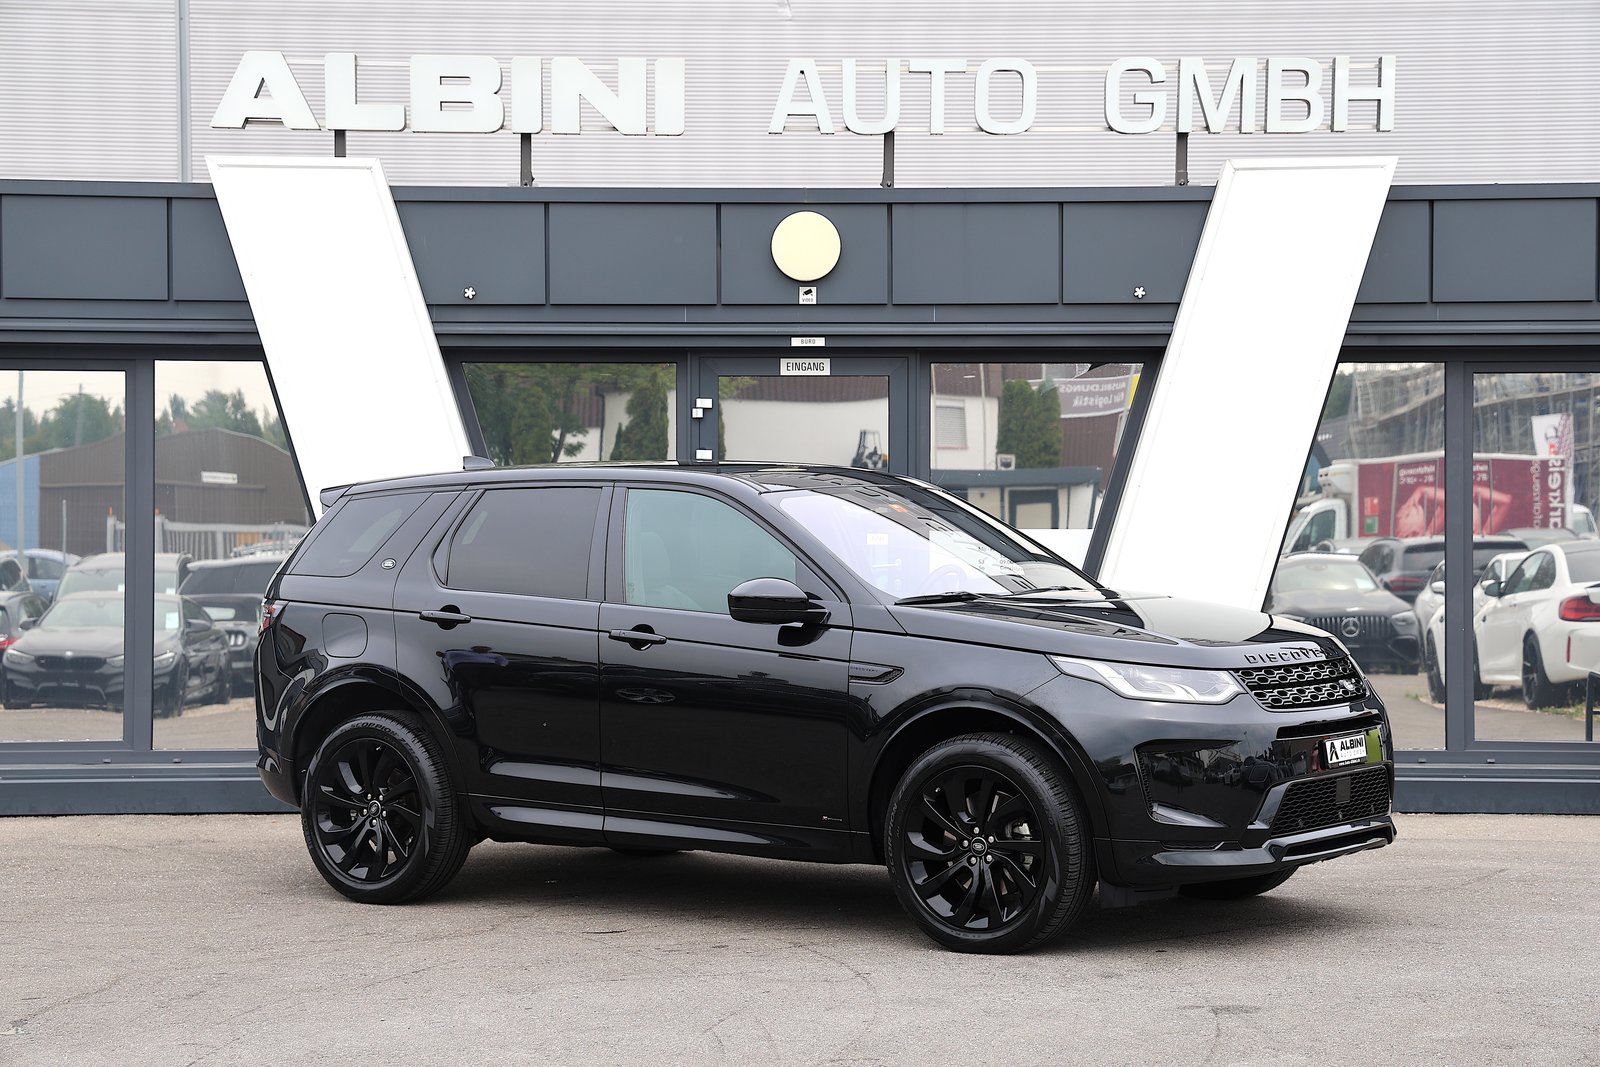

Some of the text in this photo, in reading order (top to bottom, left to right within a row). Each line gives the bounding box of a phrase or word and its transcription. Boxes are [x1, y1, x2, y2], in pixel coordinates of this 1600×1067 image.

[210, 50, 1396, 137] ALBINI AUTO GMBH
[786, 361, 825, 372] EINGANG
[1340, 737, 1364, 751] ALBINI
